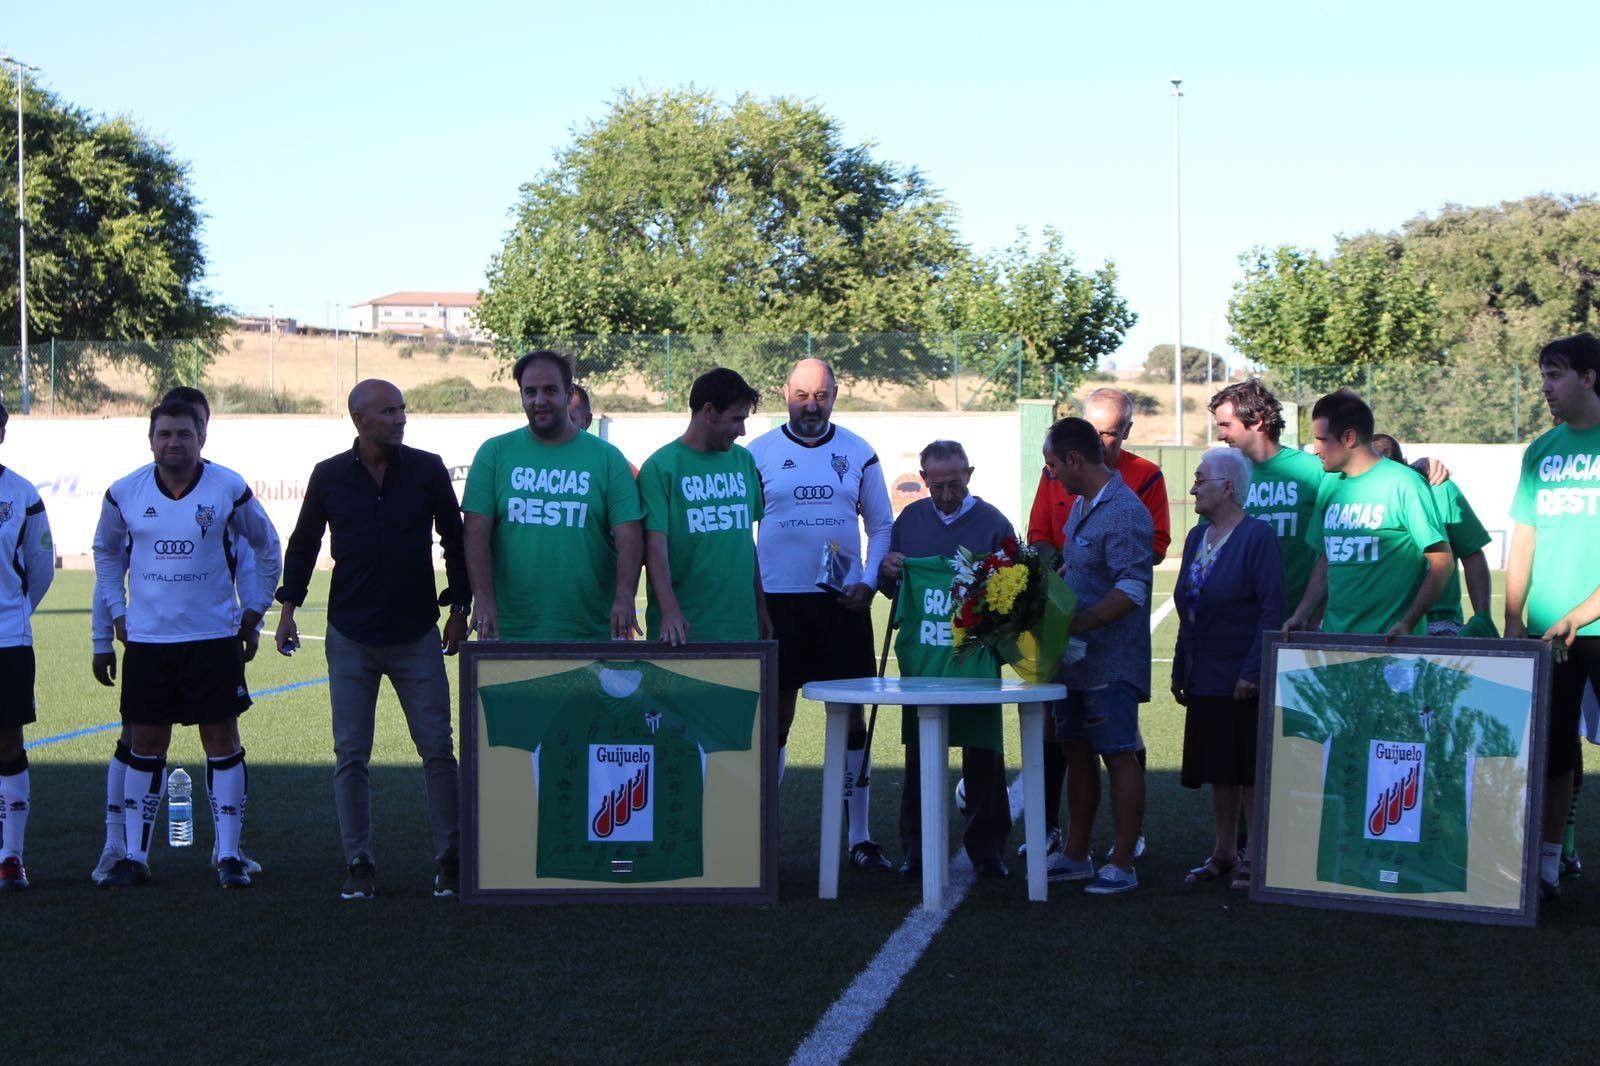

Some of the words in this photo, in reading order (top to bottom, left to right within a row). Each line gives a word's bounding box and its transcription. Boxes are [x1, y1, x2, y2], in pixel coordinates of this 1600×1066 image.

[511, 466, 590, 496] GRACIAS
[1539, 454, 1600, 482] GRACIA
[254, 480, 306, 501] Rubi
[681, 471, 747, 502] GRACIAS
[1243, 481, 1298, 508] ACIAS
[508, 496, 588, 528] RESTI
[1536, 487, 1600, 516] REST
[686, 504, 750, 533] RESTI
[780, 518, 846, 528] VITALDENT
[1324, 503, 1384, 530] GRACIAS
[143, 573, 209, 582] VITALDENT
[596, 746, 650, 768] Guijuelo
[1376, 743, 1422, 765] Guijuelo
